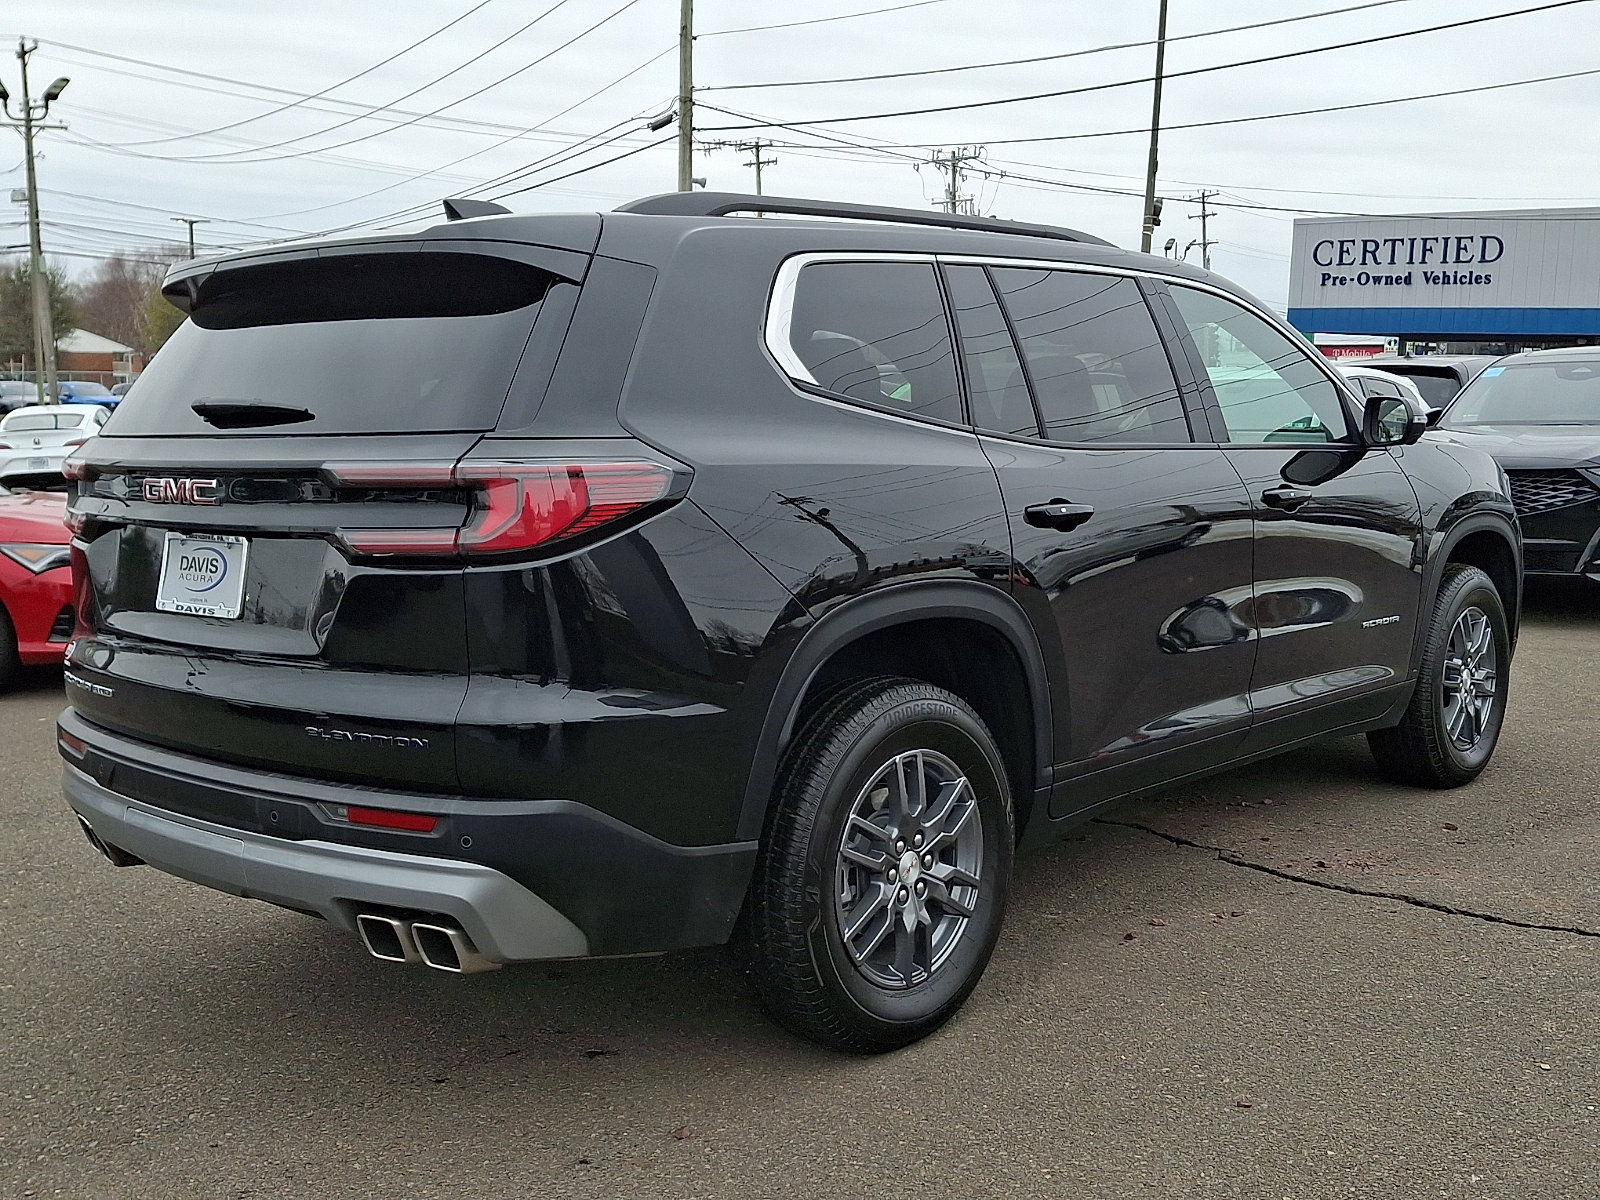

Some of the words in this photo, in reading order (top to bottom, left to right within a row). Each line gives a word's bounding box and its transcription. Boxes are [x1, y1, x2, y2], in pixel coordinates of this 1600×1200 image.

[1312, 235, 1505, 267] CERTIFIED
[1320, 271, 1413, 286] Pre-Owned
[1422, 270, 1492, 285] Vehicles
[142, 478, 219, 505] GMC
[179, 555, 219, 574] DAVIS
[178, 573, 214, 583] ACURA
[175, 604, 216, 615] DAVIS
[1362, 615, 1400, 629] ACADIA
[304, 726, 430, 749] ELEVATION
